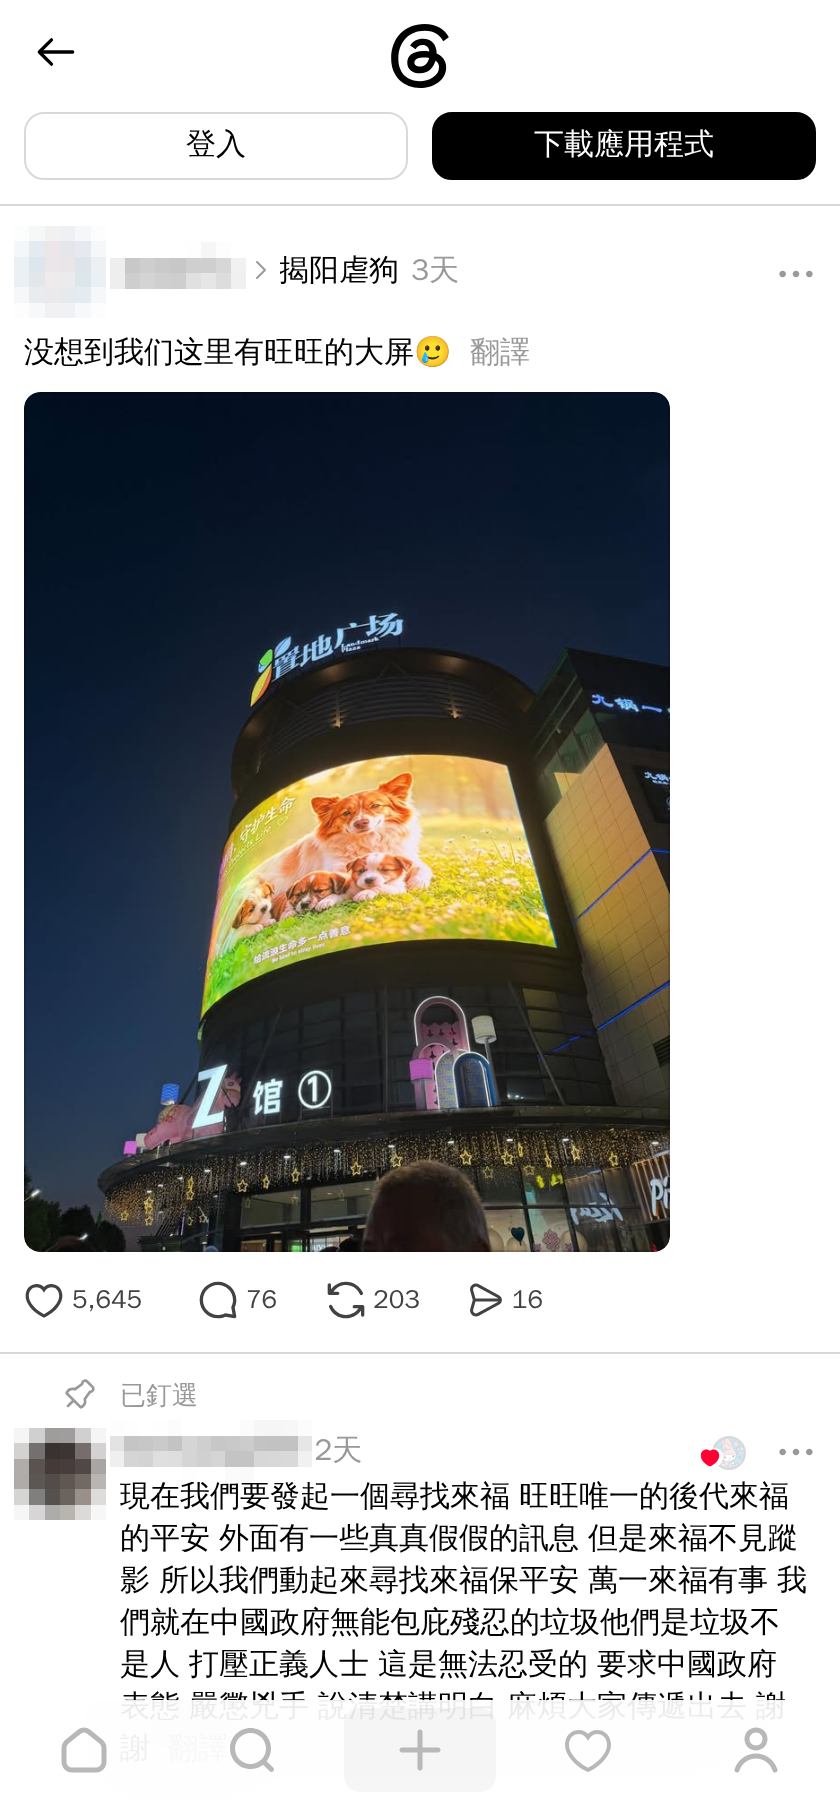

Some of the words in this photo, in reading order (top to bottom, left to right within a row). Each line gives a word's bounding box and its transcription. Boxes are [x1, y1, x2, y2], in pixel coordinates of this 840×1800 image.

[186, 129, 245, 159] 登入
[534, 129, 713, 158] 下載應用程式
[280, 255, 397, 284] 揭阳虐狗
[412, 257, 457, 283] 3天
[24, 336, 414, 367] 没想到我们这里有旺旺的大屏
[471, 337, 529, 366] 翻譯
[272, 612, 404, 682] 置地广场
[591, 693, 670, 713] 九锅一
[240, 796, 296, 843] 守护生命
[191, 1064, 228, 1129] Z
[252, 1078, 284, 1116] 馆
[73, 1290, 141, 1312] 5,645
[248, 1290, 276, 1309] 76
[374, 1290, 419, 1309] 203
[513, 1290, 542, 1309] 16
[122, 1383, 196, 1408] 已釘選
[316, 1437, 361, 1463] 2天
[120, 1481, 509, 1511] 現在我們要發起一個尋找來福
[521, 1481, 788, 1511] 旺旺唯一的後代來福
[121, 1522, 209, 1553] 的平安
[219, 1523, 578, 1553] 外面有一些真真假假的訊息
[588, 1523, 797, 1553] 但是來福不見蹤
[121, 1565, 149, 1595] 影
[160, 1564, 578, 1595] 所以我們動起來尋找來福保平安
[588, 1565, 767, 1595] 萬一來福有事
[777, 1565, 806, 1595] 我
[120, 1606, 778, 1637] 們就在中國政府無能包庇殘忍的垃圾他們是垃圾不
[121, 1650, 179, 1679] 是人
[189, 1649, 368, 1679] 打壓正義人士
[379, 1649, 587, 1679] 這是無法忍受的
[597, 1648, 776, 1679] 要求中國政府
[121, 1691, 179, 1721] 表態
